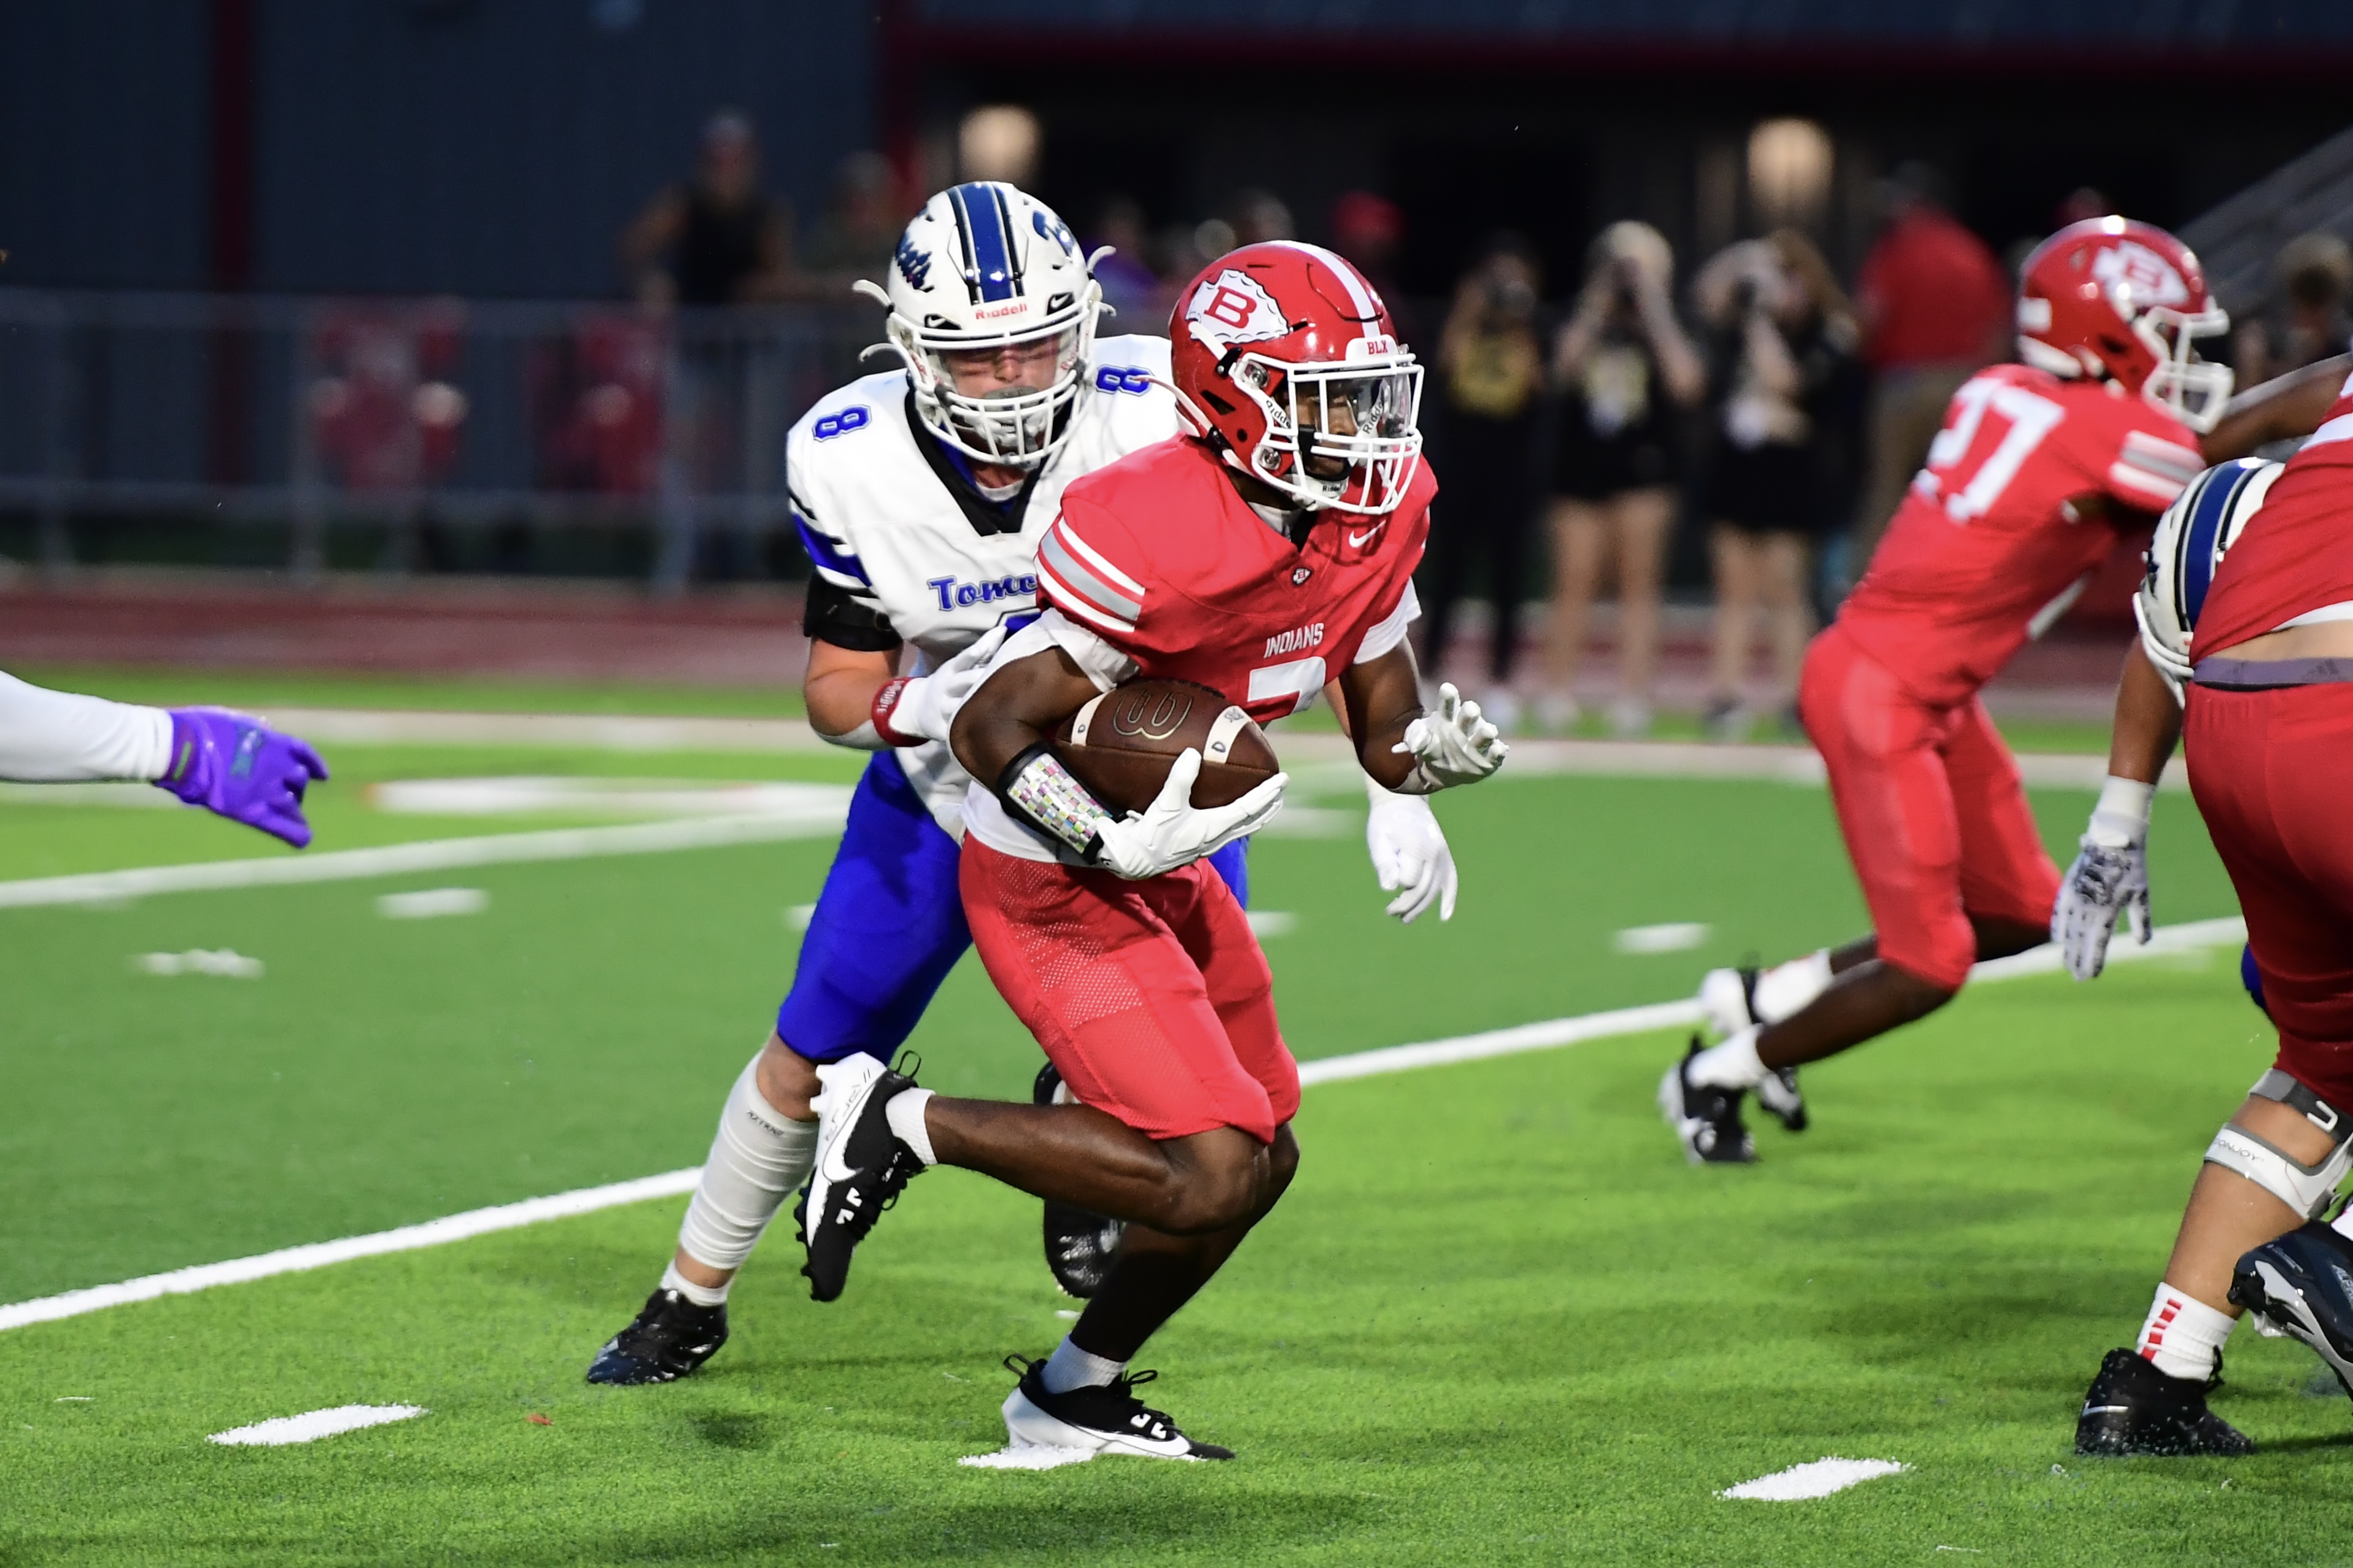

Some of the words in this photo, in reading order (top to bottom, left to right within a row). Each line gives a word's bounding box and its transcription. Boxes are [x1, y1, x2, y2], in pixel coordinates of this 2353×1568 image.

[975, 303, 1028, 320] Riddell
[1204, 285, 1257, 329] B
[1366, 339, 1389, 355] BLX
[1095, 364, 1155, 397] 8
[812, 404, 872, 442] 8
[1266, 400, 1292, 430] Ridde
[927, 572, 1038, 611] Tomc
[1263, 622, 1324, 658] INDIANS
